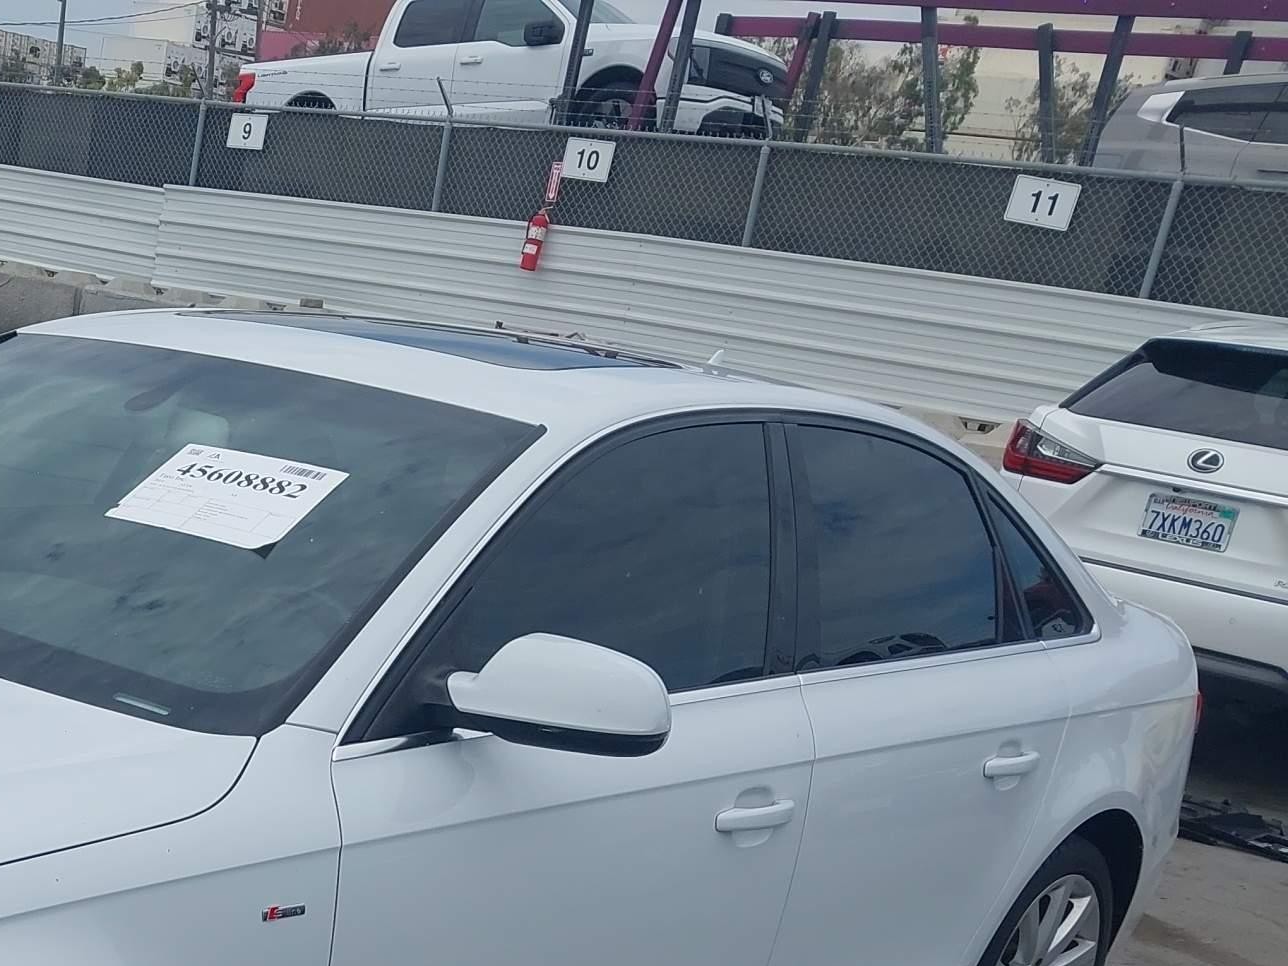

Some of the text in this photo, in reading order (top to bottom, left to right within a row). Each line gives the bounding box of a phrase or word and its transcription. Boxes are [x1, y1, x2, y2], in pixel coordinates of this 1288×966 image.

[242, 122, 252, 140] 9
[577, 148, 600, 171] 10
[1031, 190, 1059, 216] 11
[176, 462, 308, 499] 45608882
[1149, 510, 1225, 543] 7XKM360
